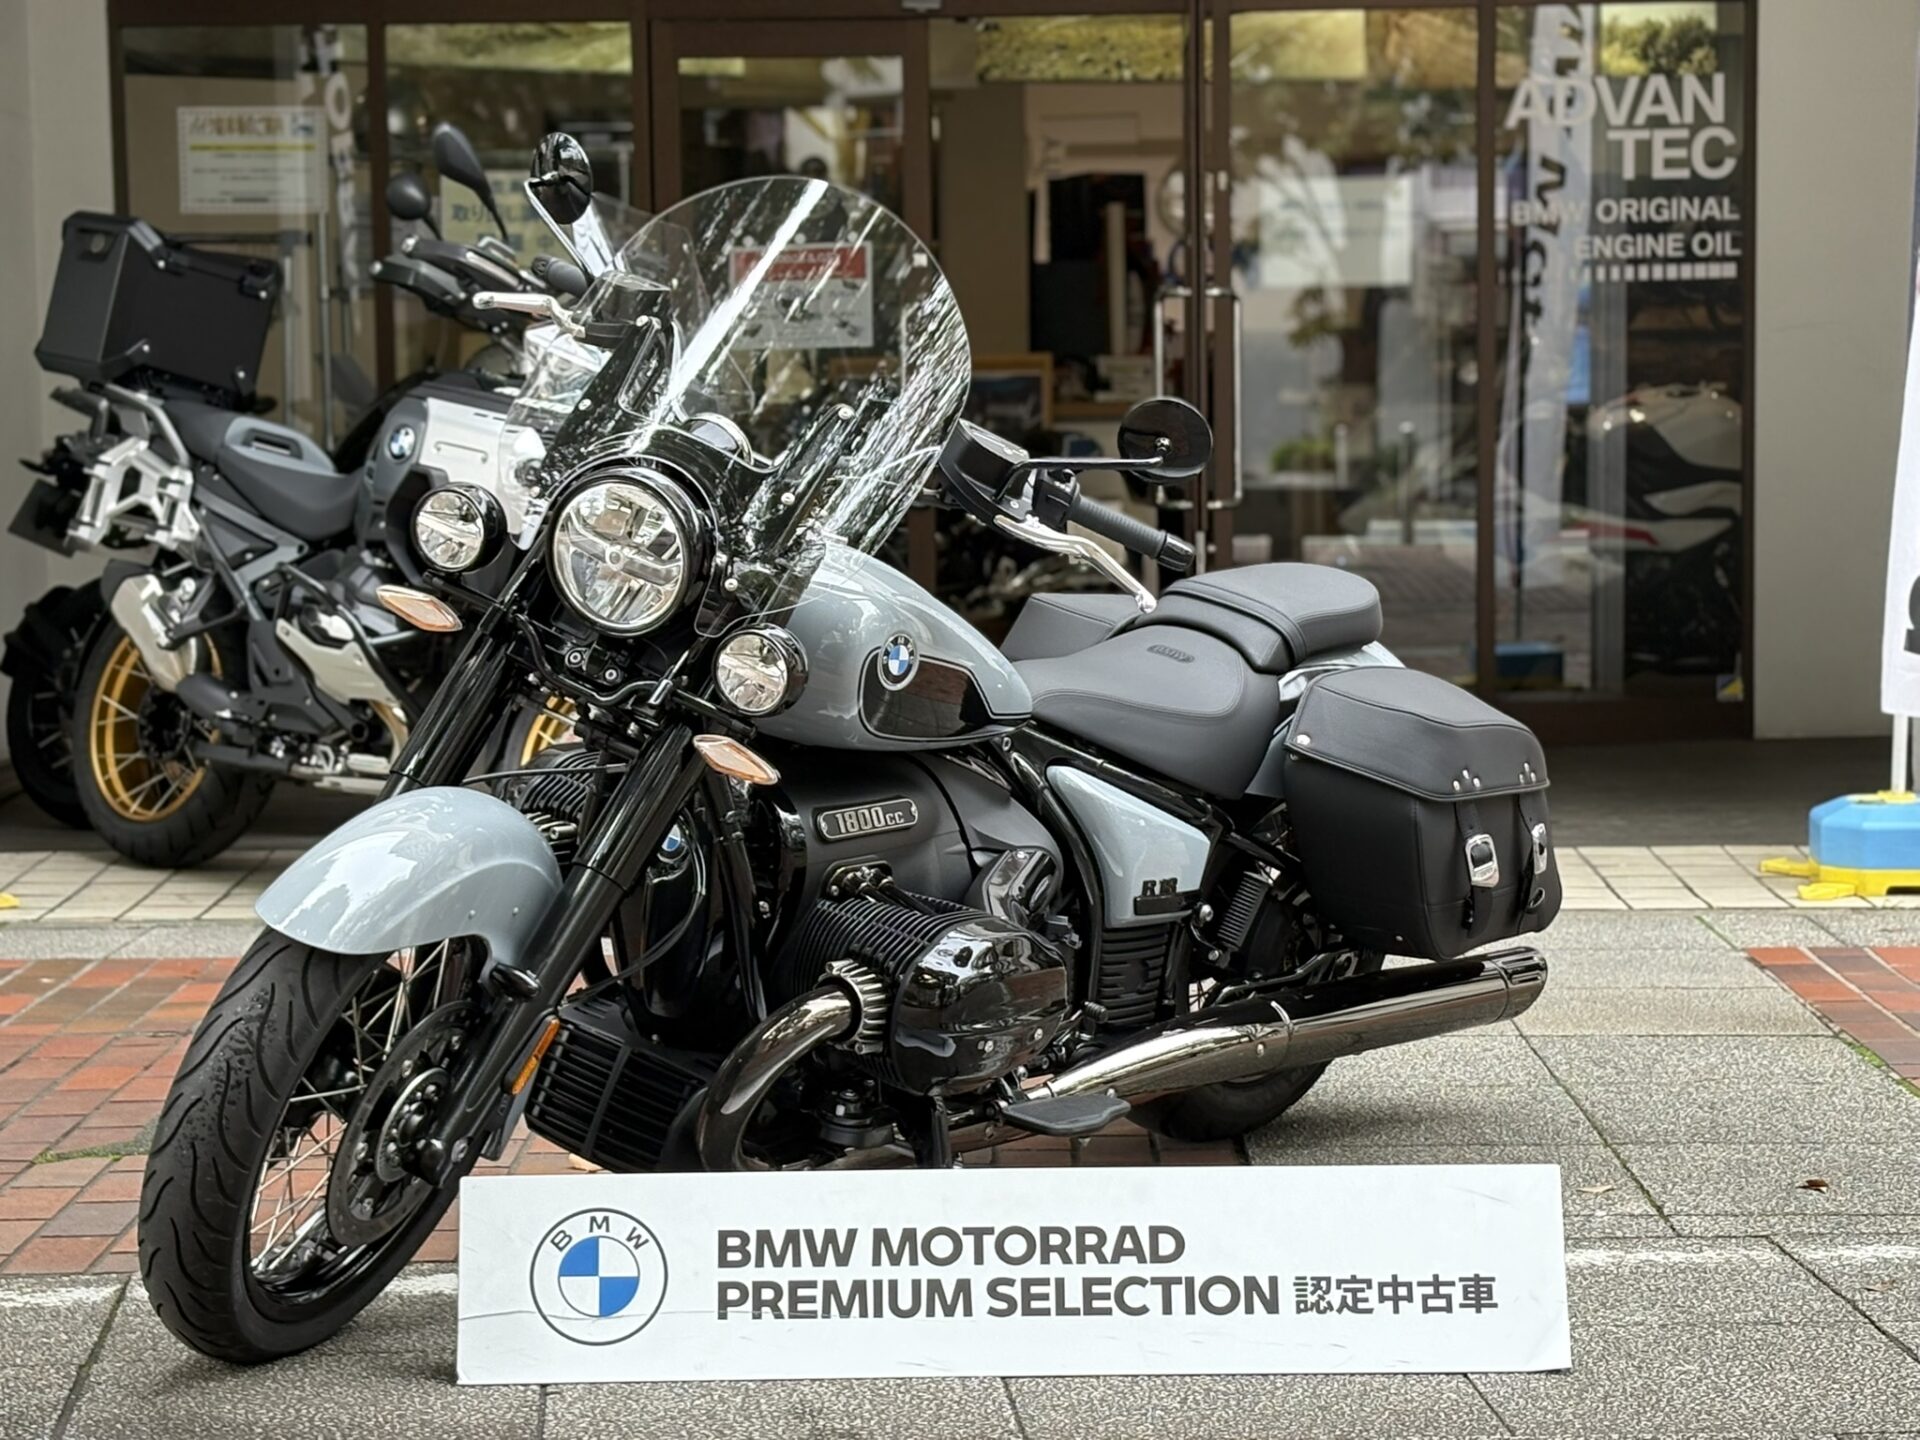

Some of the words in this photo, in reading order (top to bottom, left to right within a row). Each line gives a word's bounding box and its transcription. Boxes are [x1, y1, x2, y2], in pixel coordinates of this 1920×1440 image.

[1504, 72, 1726, 130] ADVAN
[1606, 126, 1738, 181] TEC
[1596, 196, 1741, 224] ORIGINAL
[1574, 232, 1686, 259] ENGINE
[1691, 231, 1742, 257] OIL
[834, 806, 905, 834] 1800cc
[549, 1215, 650, 1252] BMW
[717, 1227, 858, 1269] BMW
[871, 1225, 1186, 1267] MOTORRAD
[717, 1277, 973, 1320] PREMIUM
[986, 1274, 1280, 1317] SELECTION
[1293, 1273, 1499, 1315] 認定中古車
